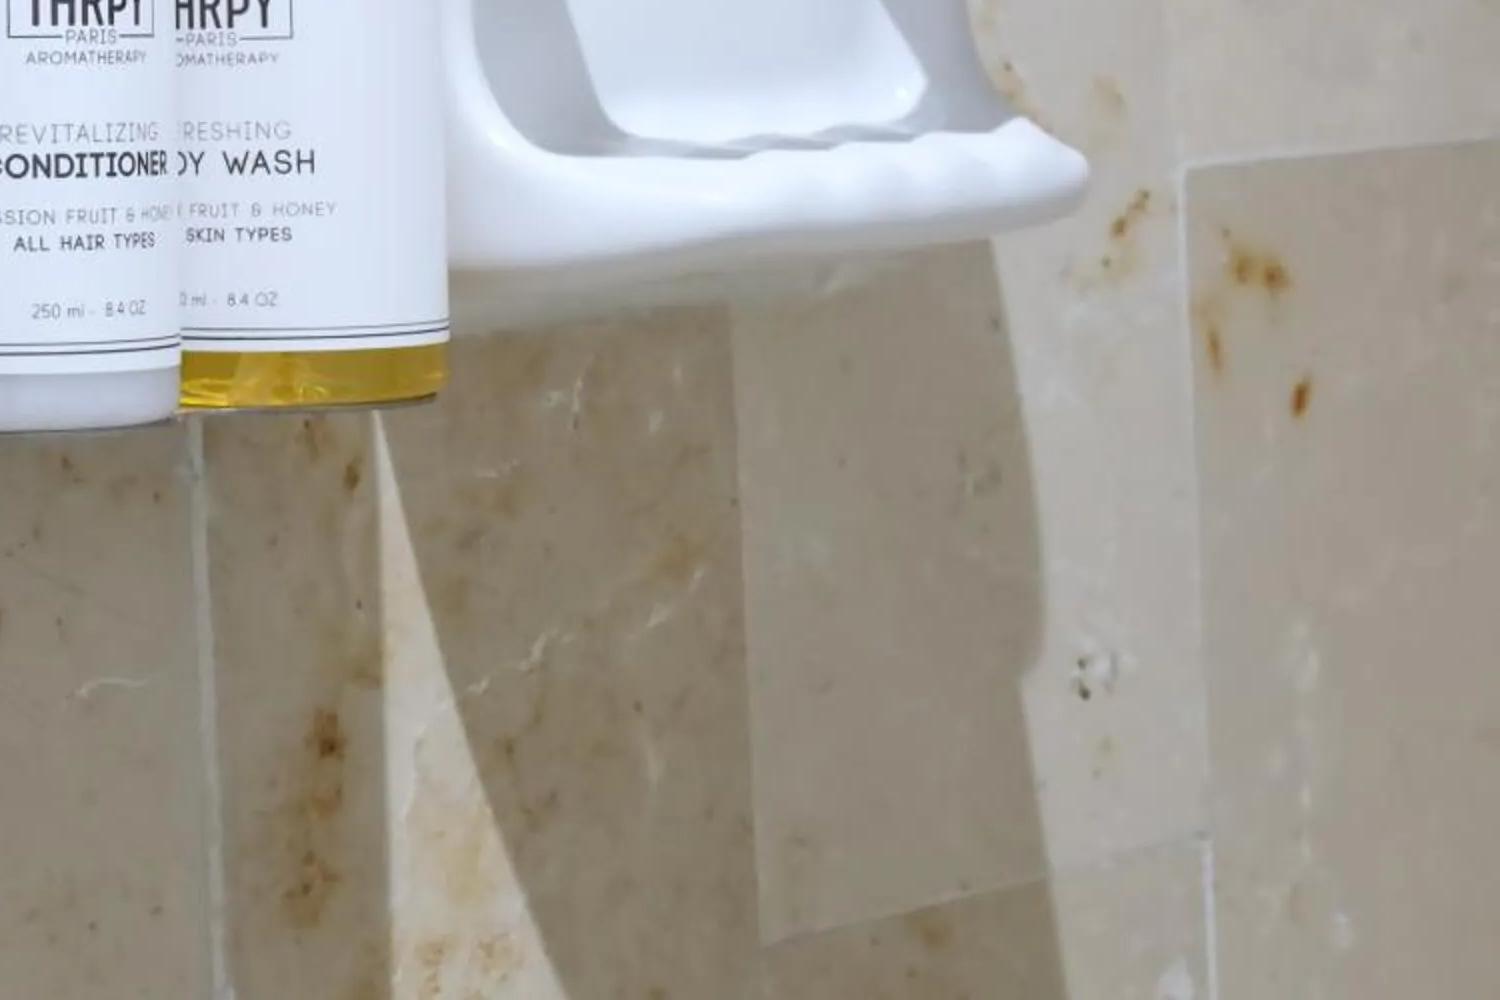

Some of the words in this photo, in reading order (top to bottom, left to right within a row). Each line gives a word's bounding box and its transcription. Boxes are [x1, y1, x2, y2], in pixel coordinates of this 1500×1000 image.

[65, 29, 117, 44] PARIS
[185, 31, 237, 47] PARIS
[25, 49, 147, 65] AROMATHERAPY
[0, 121, 158, 145] REVITALIZING
[177, 120, 292, 143] RESHING
[222, 149, 316, 175] WASH
[66, 207, 118, 224] FRUIT
[189, 202, 239, 219] FRUIT
[272, 200, 337, 218] HONEY
[13, 236, 50, 252] ALL
[60, 235, 105, 251] HAIR
[114, 231, 155, 249] TYPES
[186, 227, 225, 243] SKIN
[236, 226, 293, 242] TYPES
[31, 303, 62, 319] 250
